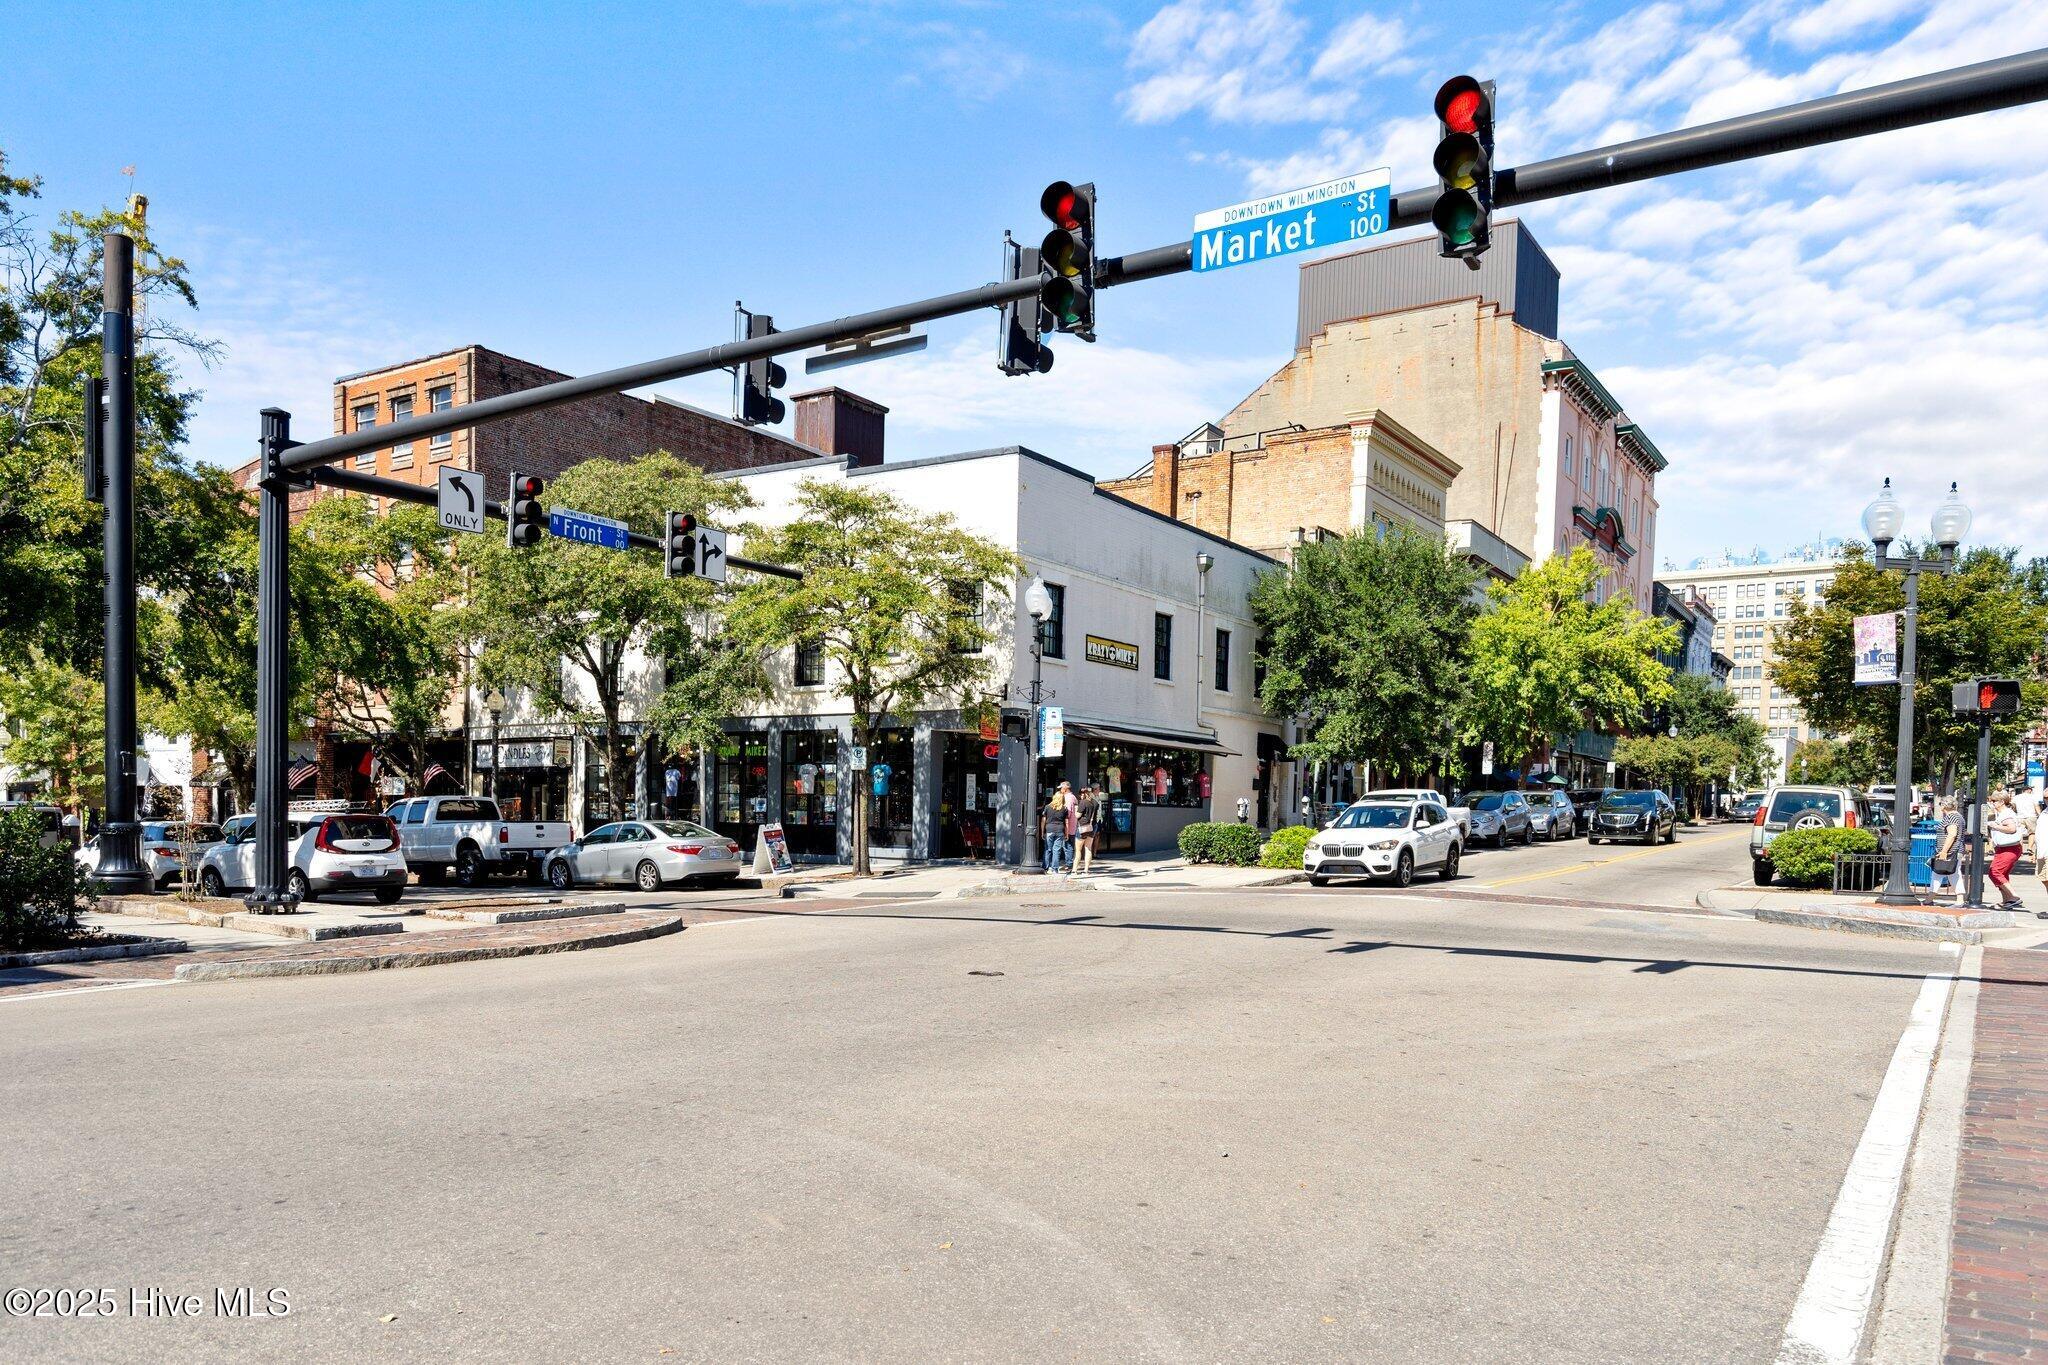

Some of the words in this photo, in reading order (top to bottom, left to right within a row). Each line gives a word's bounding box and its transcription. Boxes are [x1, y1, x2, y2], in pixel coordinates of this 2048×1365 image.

[1224, 198, 1283, 222] DOWNTOWN
[1288, 180, 1356, 207] WILMINGTON
[1200, 209, 1317, 269] Market
[1356, 190, 1376, 213] St
[1350, 213, 1382, 238] 100
[445, 512, 479, 528] ONLY
[563, 509, 589, 520] DOWNTOWN
[590, 516, 617, 526] WILMINGTON
[553, 515, 559, 525] N
[564, 518, 602, 543] Front
[616, 528, 624, 539] St
[615, 539, 625, 549] 00
[1087, 641, 1110, 659] KRAZY
